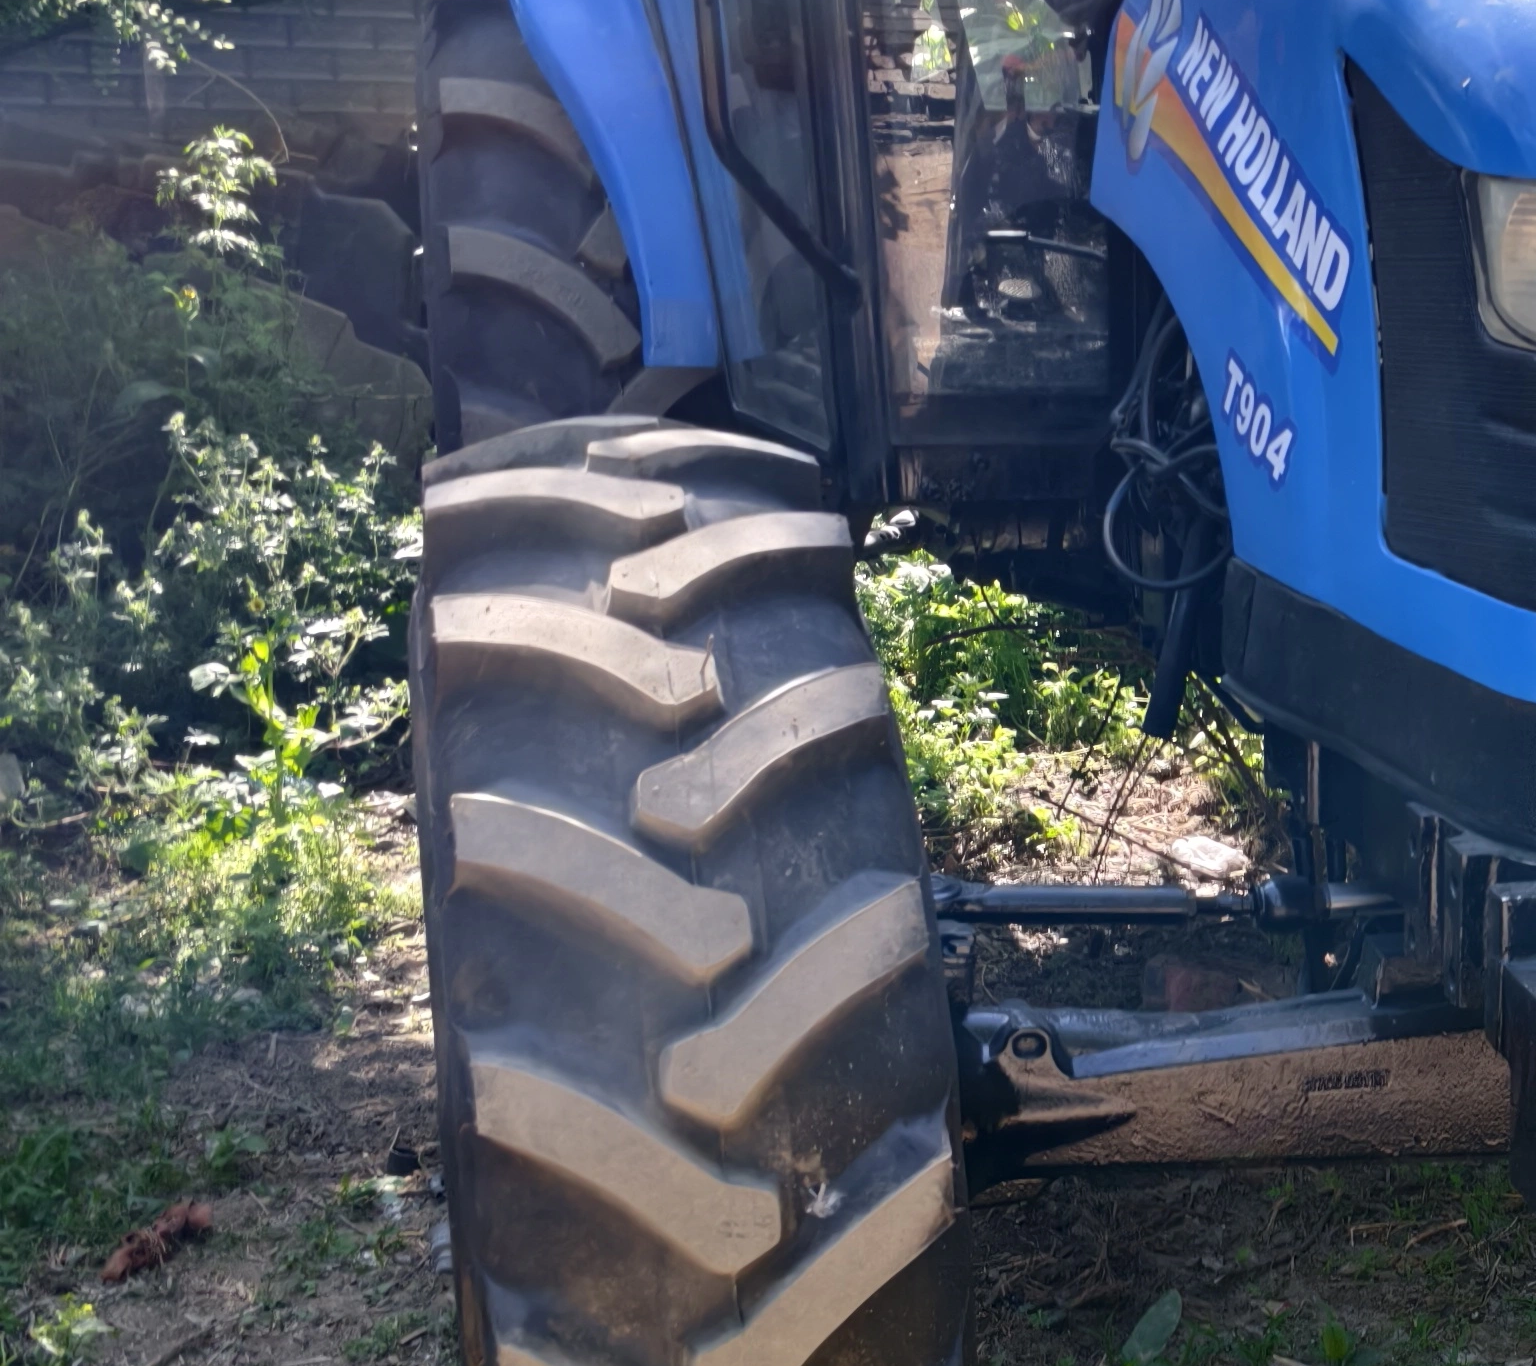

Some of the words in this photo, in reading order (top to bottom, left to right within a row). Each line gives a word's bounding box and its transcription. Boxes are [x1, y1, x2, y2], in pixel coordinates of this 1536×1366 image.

[1177, 16, 1239, 132] NEW
[1217, 92, 1350, 312] HOLLAND
[1224, 358, 1293, 482] T904
